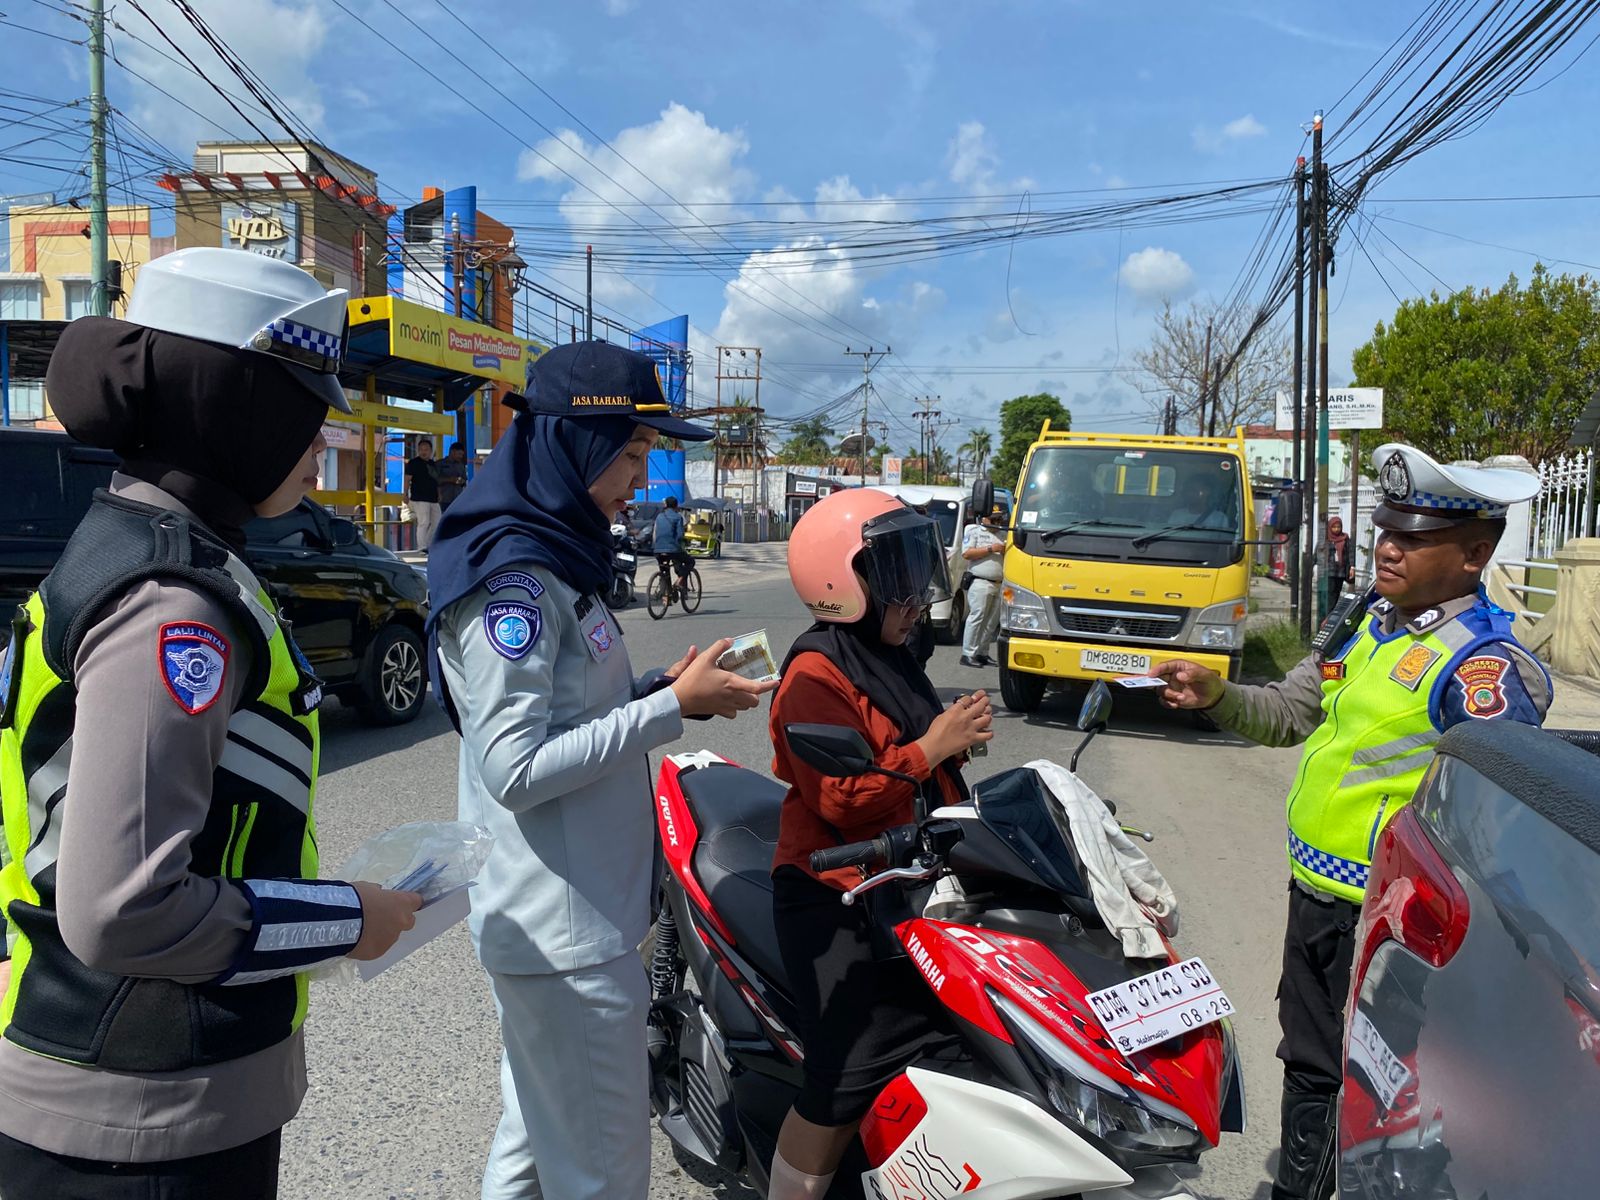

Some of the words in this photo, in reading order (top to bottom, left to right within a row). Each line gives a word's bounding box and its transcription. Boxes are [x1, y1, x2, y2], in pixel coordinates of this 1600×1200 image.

[400, 322, 440, 346] maxim
[450, 333, 472, 350] Pesan
[572, 396, 591, 406] JASA
[593, 396, 632, 406] RAHARJA
[490, 575, 539, 593] GORONTALO
[1062, 585, 1182, 598] FUSO
[490, 606, 508, 617] JASA
[508, 607, 537, 621] RAHARJA
[166, 628, 195, 636] LALU
[198, 629, 227, 652] LINTAS
[1086, 651, 1101, 662] DM
[1101, 652, 1129, 667] 8028
[907, 932, 946, 992] YAMAHA
[1090, 990, 1131, 1022] DM
[1128, 971, 1182, 1007] 3743
[1181, 961, 1212, 989] SD
